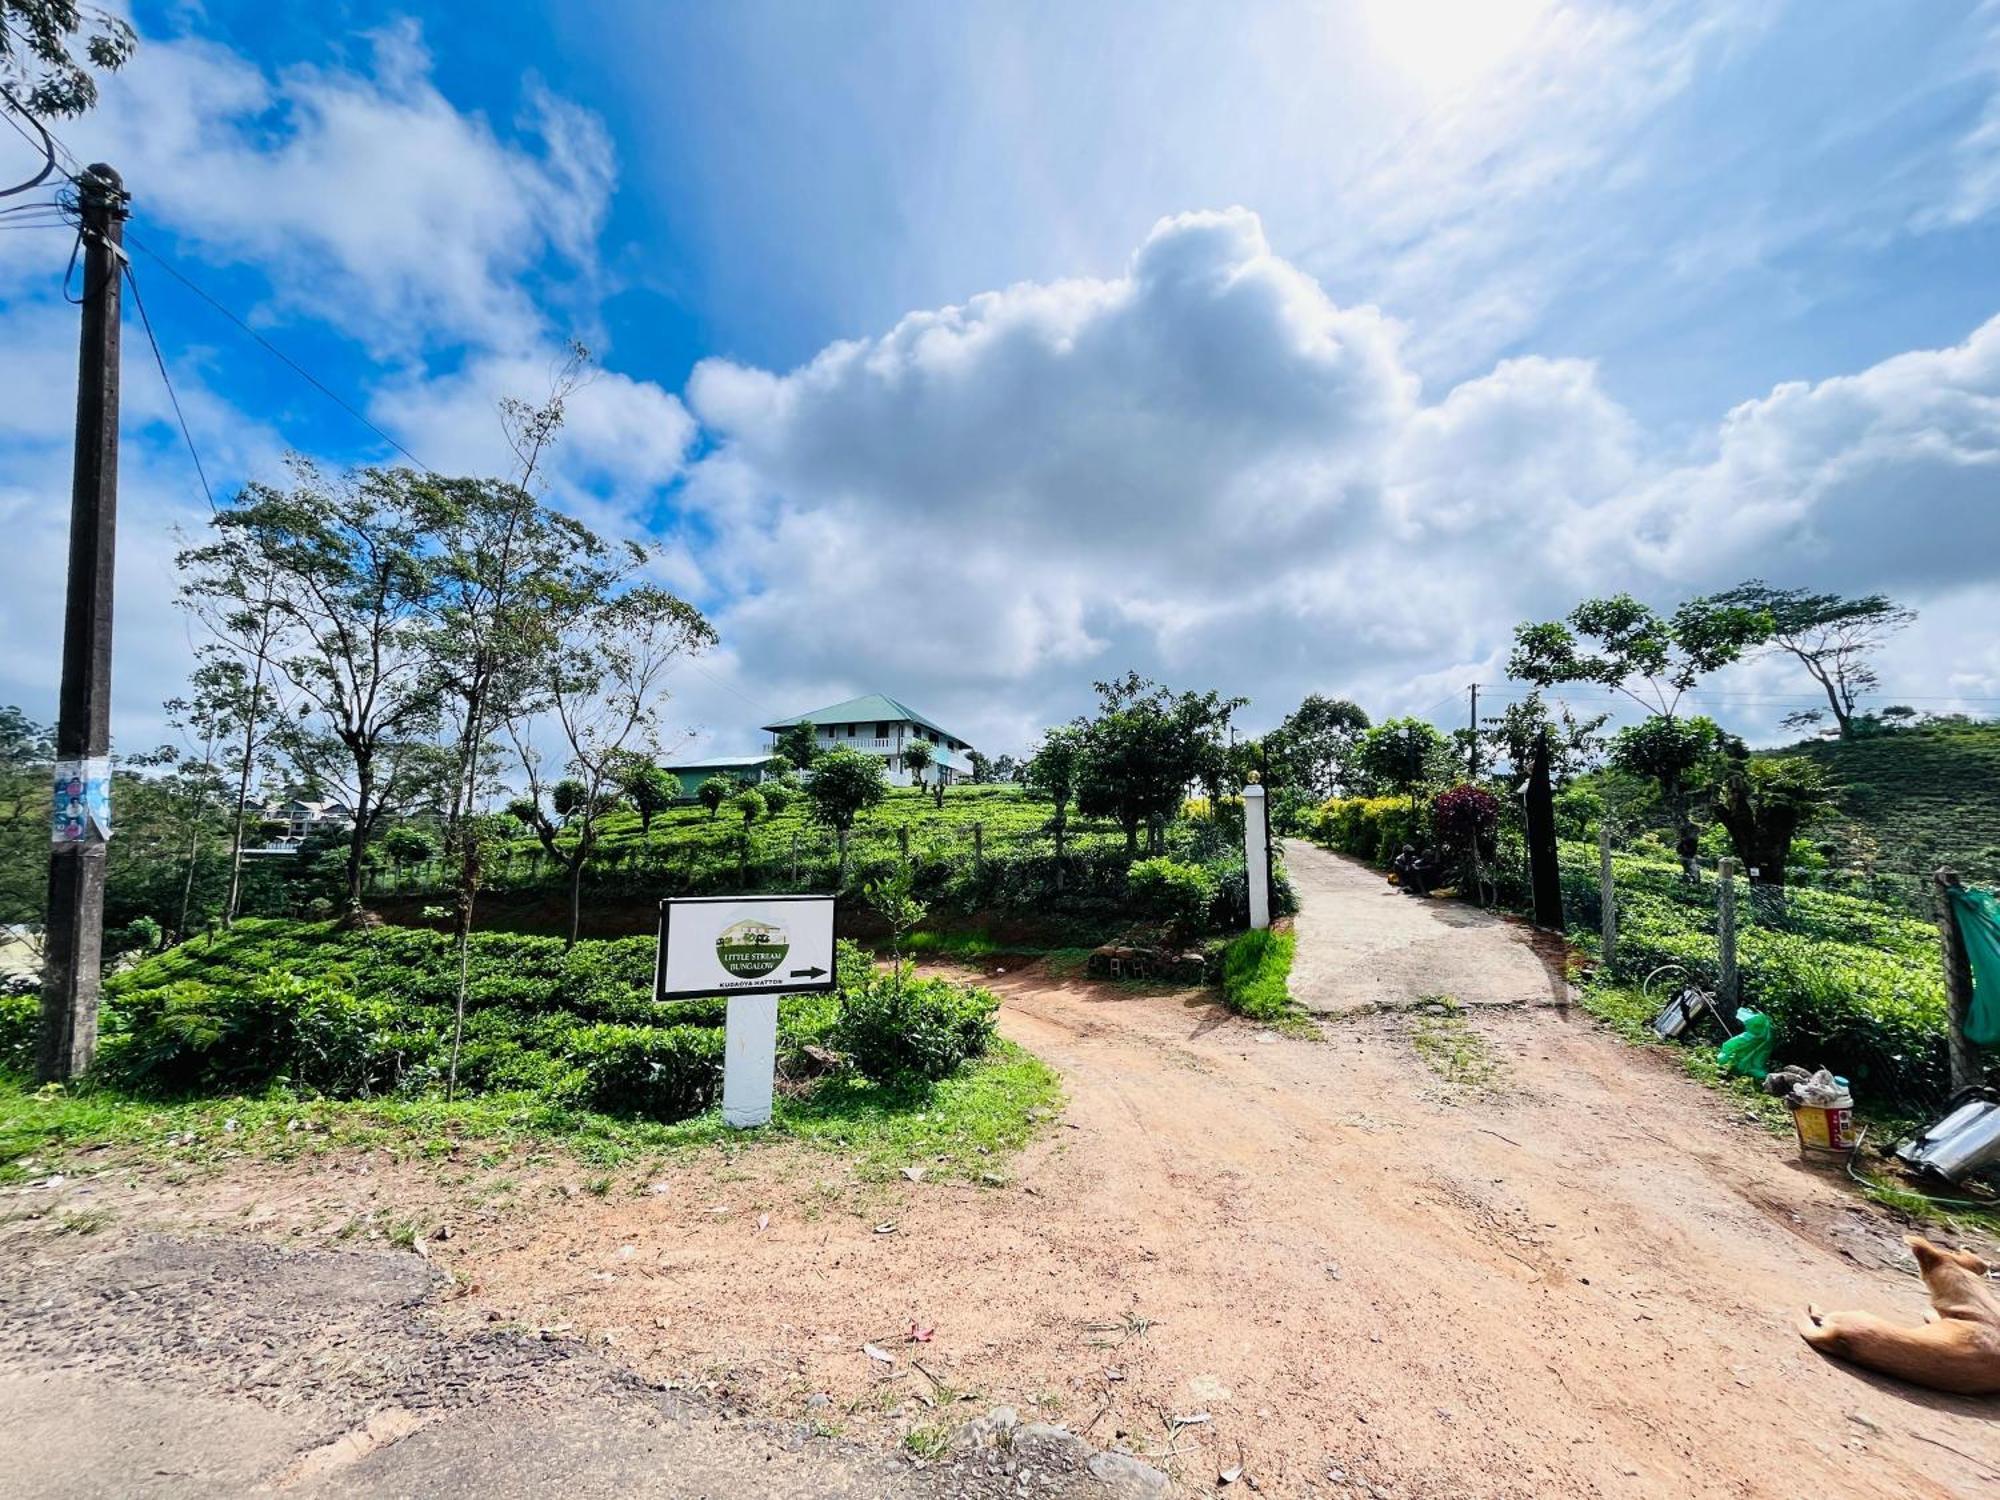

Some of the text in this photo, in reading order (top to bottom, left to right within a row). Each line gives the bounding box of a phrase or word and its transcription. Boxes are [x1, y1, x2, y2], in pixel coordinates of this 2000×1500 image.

[724, 952, 782, 961] LITTLE STREAM
[730, 962, 774, 971] BUNGALOW
